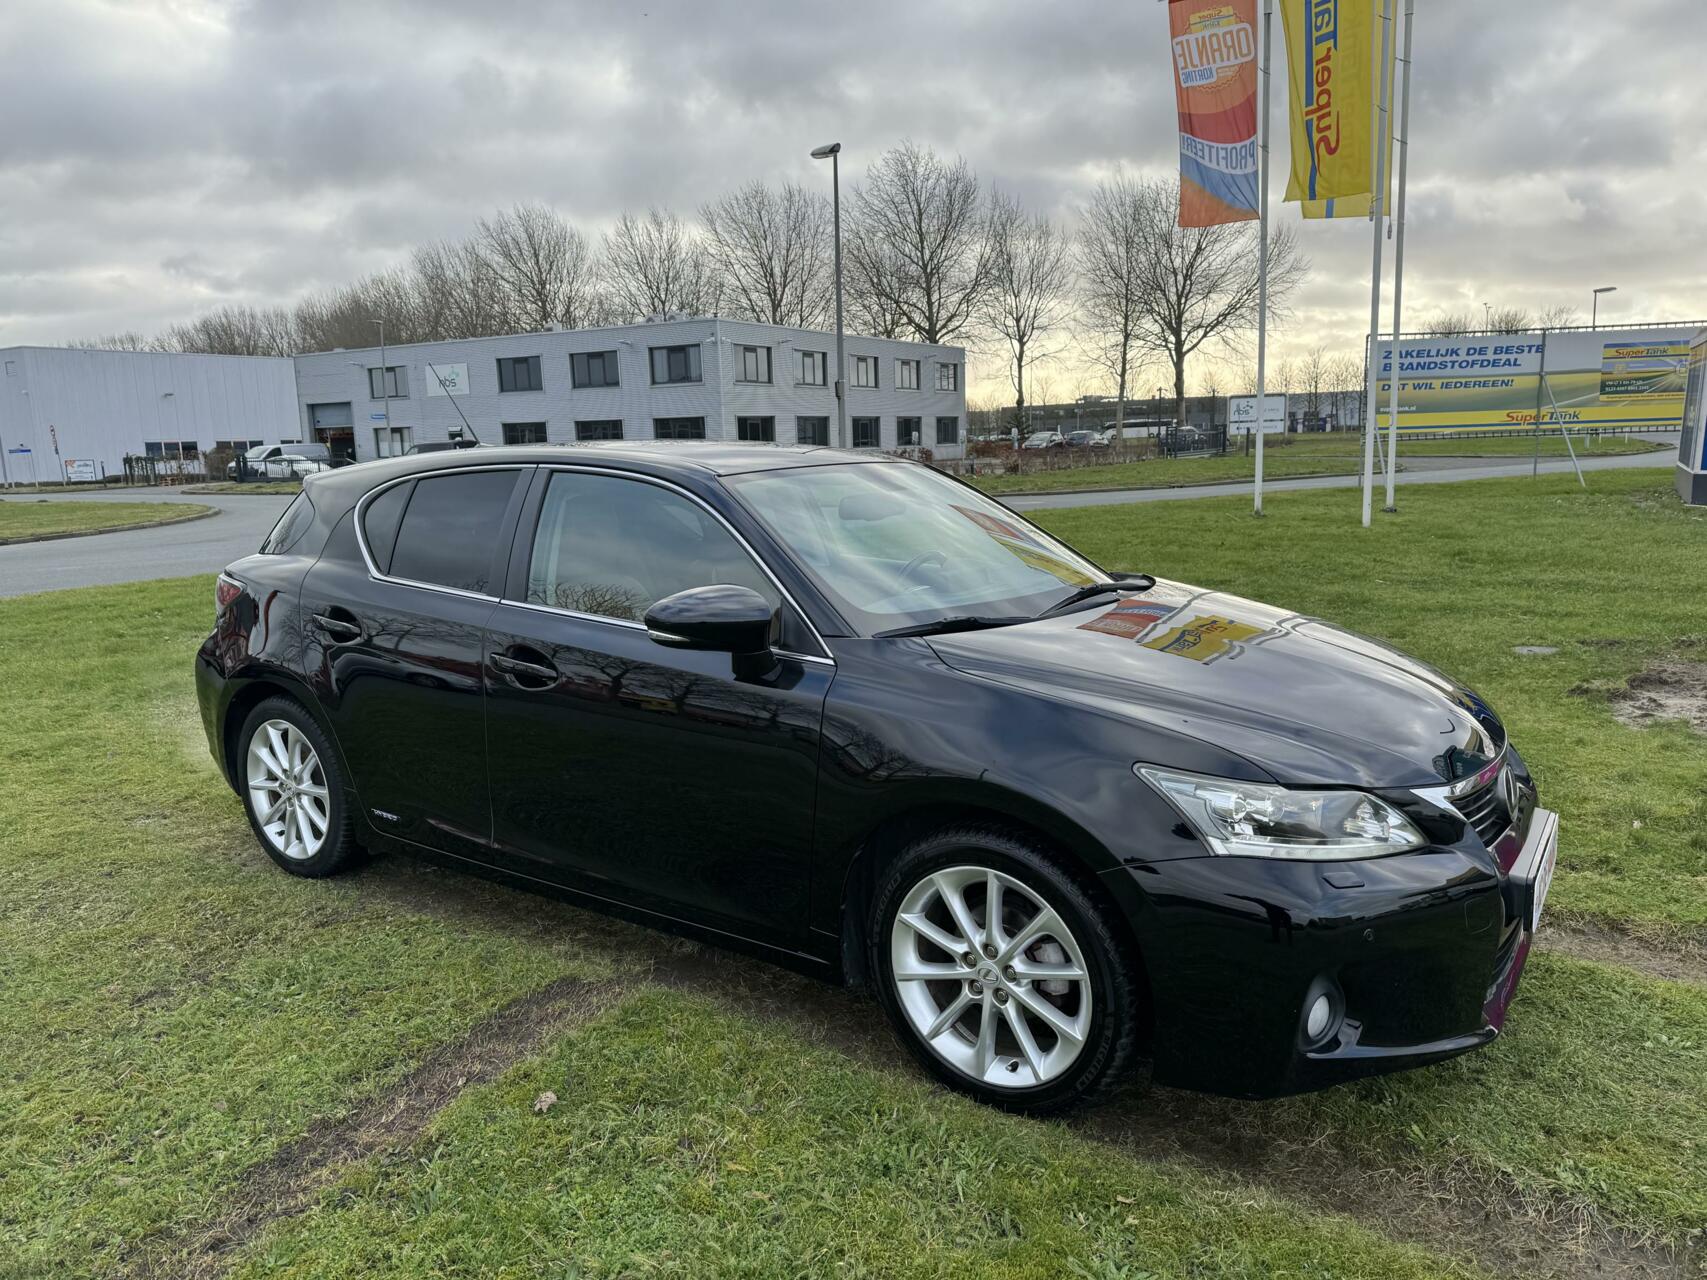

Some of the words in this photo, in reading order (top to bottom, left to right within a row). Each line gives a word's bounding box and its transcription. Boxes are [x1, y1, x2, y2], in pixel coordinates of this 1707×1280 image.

[1465, 346, 1489, 357] DE
[1492, 344, 1546, 355] BESTE
[1382, 358, 1522, 372] BRANDSTOFDEAL
[1381, 383, 1408, 392] DT
[1412, 382, 1436, 391] WIL
[1440, 379, 1514, 390] IEDEREEN!
[1503, 410, 1580, 425] SuperTank
